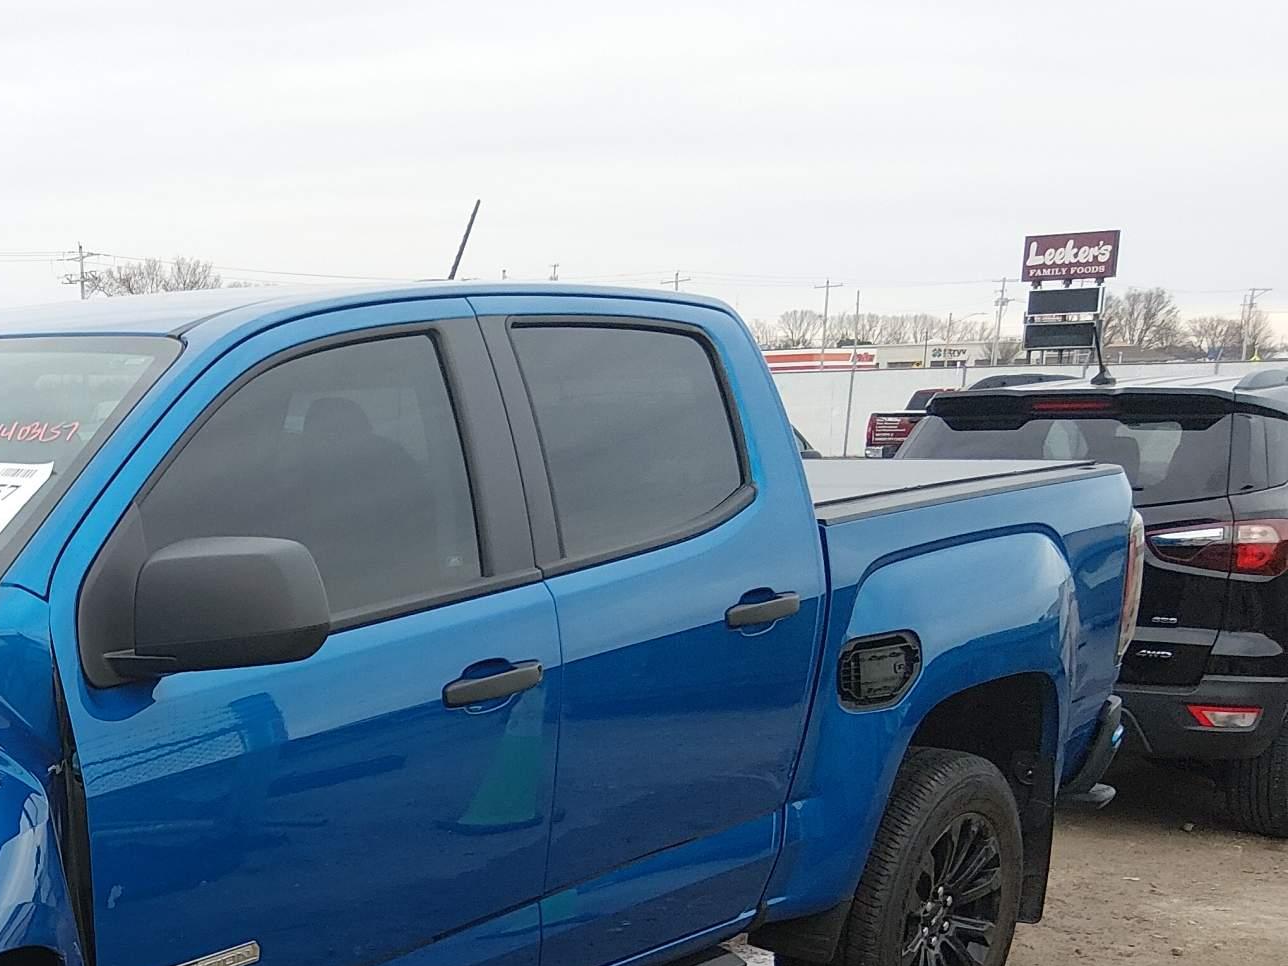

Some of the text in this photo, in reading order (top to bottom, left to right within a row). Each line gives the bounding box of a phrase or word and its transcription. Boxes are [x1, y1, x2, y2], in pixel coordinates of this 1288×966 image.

[1026, 239, 1112, 266] Leeker's
[1029, 265, 1105, 277] FAMILY FOODS
